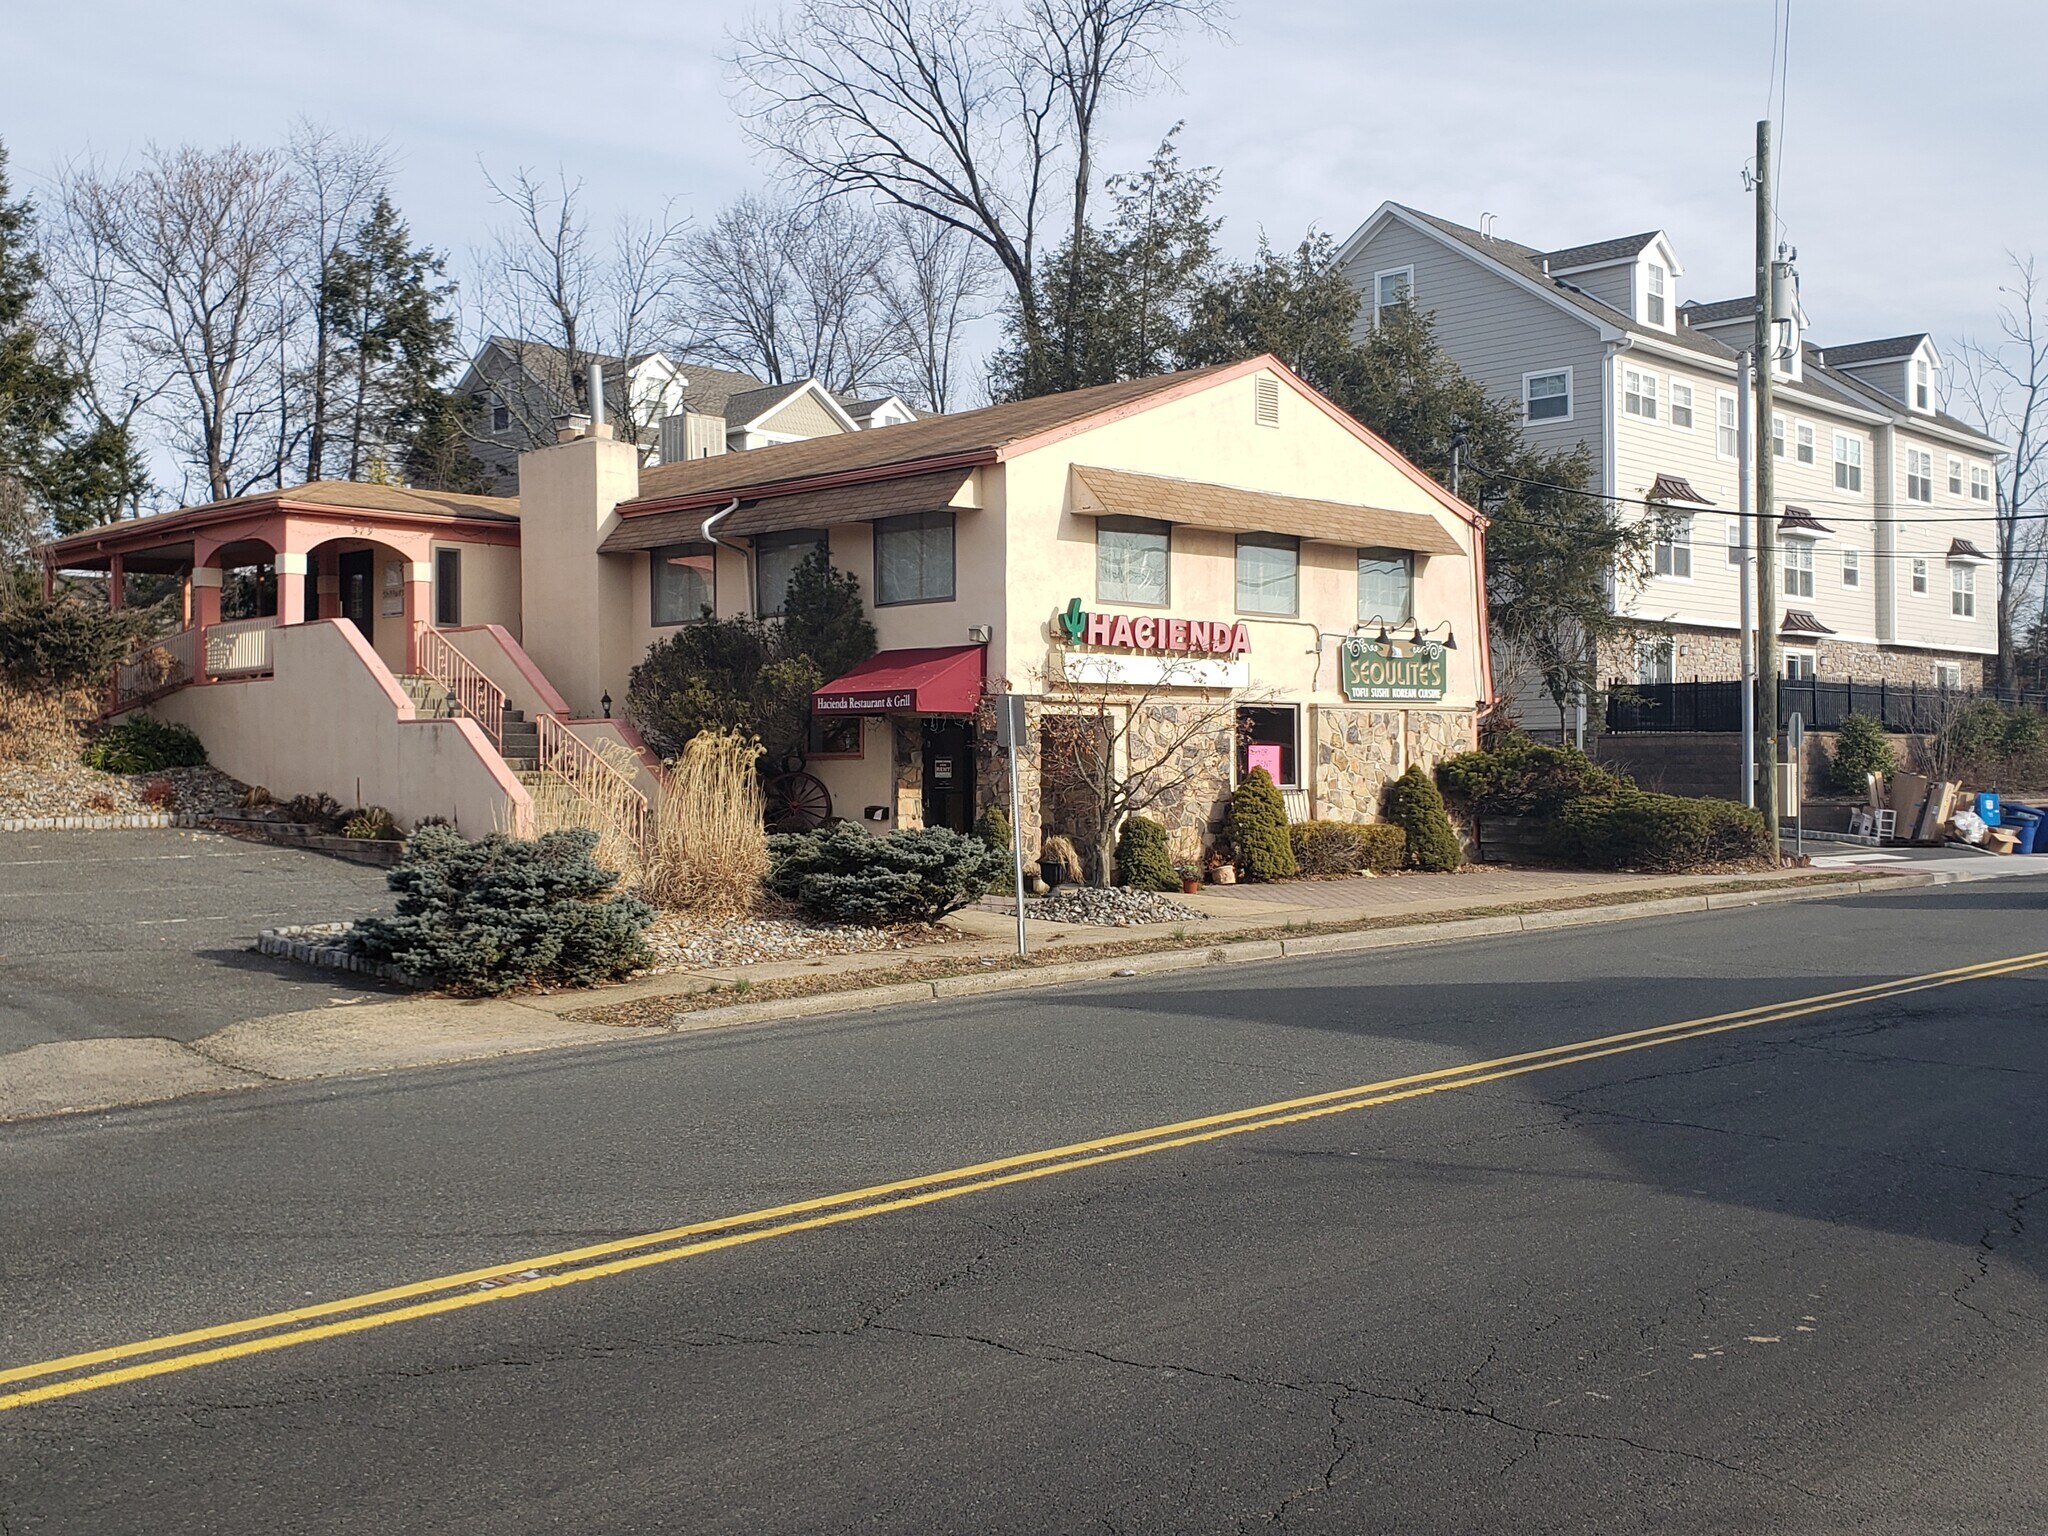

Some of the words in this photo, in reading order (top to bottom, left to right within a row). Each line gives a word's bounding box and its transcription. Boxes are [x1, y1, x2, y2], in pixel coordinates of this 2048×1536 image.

[1087, 613, 1252, 654] HACIENDA
[1350, 660, 1441, 686] SEOULITE'S
[817, 697, 848, 709] Hacienda
[849, 697, 885, 709] Restaurant
[886, 697, 893, 708] &
[894, 694, 911, 708] Grill
[1352, 687, 1369, 698] TOFU
[1371, 688, 1390, 698] SUSHI
[1392, 688, 1417, 699] KOREAN
[1418, 689, 1442, 699] CUISINE
